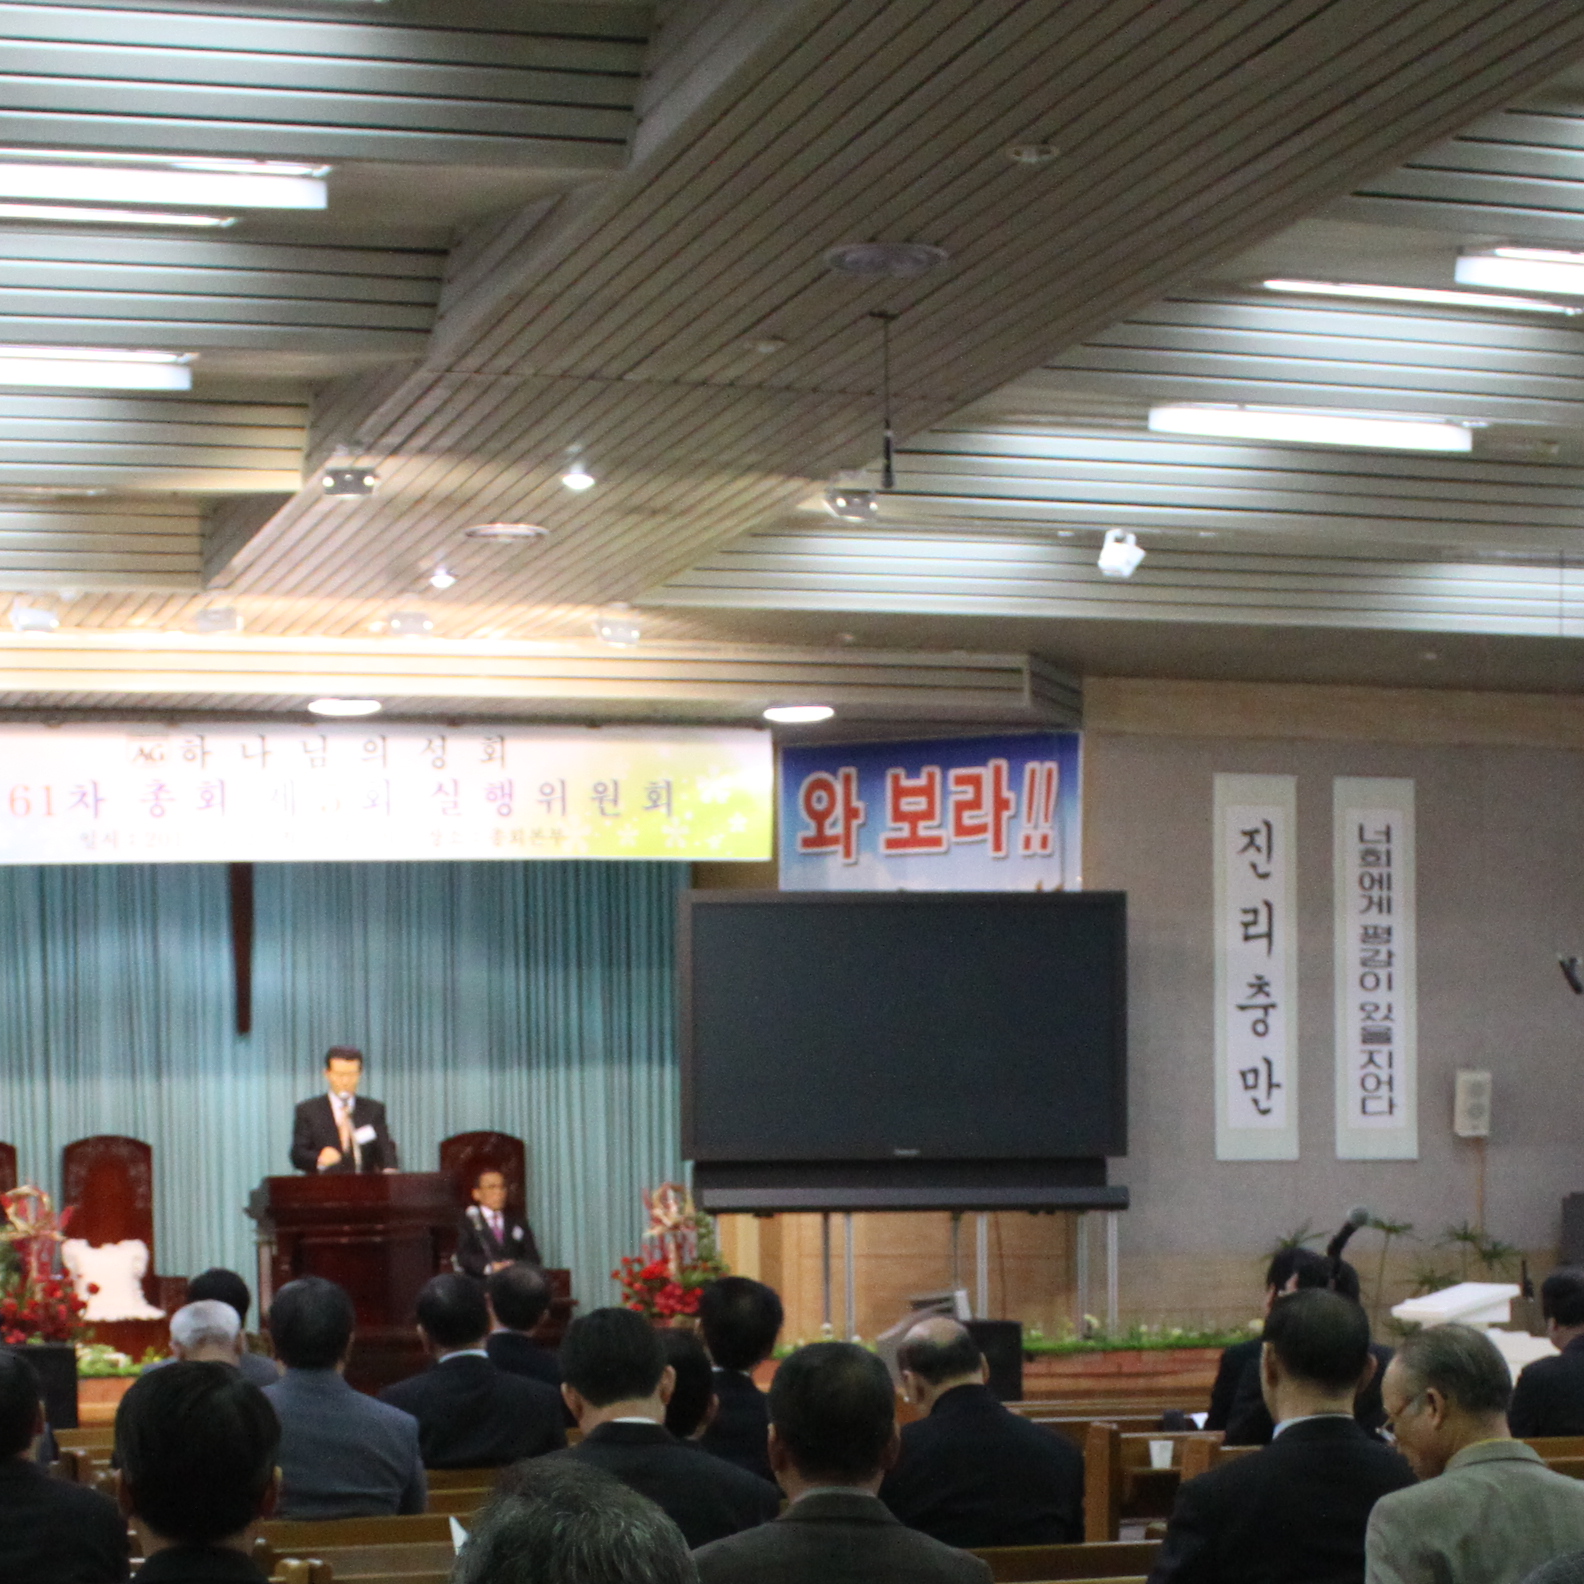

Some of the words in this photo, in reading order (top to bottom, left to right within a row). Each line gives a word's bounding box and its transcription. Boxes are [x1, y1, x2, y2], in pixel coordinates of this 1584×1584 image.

[797, 766, 865, 866] 와
[880, 759, 1061, 861] 보라!!
[1358, 823, 1392, 914] 너희에게
[1359, 924, 1396, 993] 평강이
